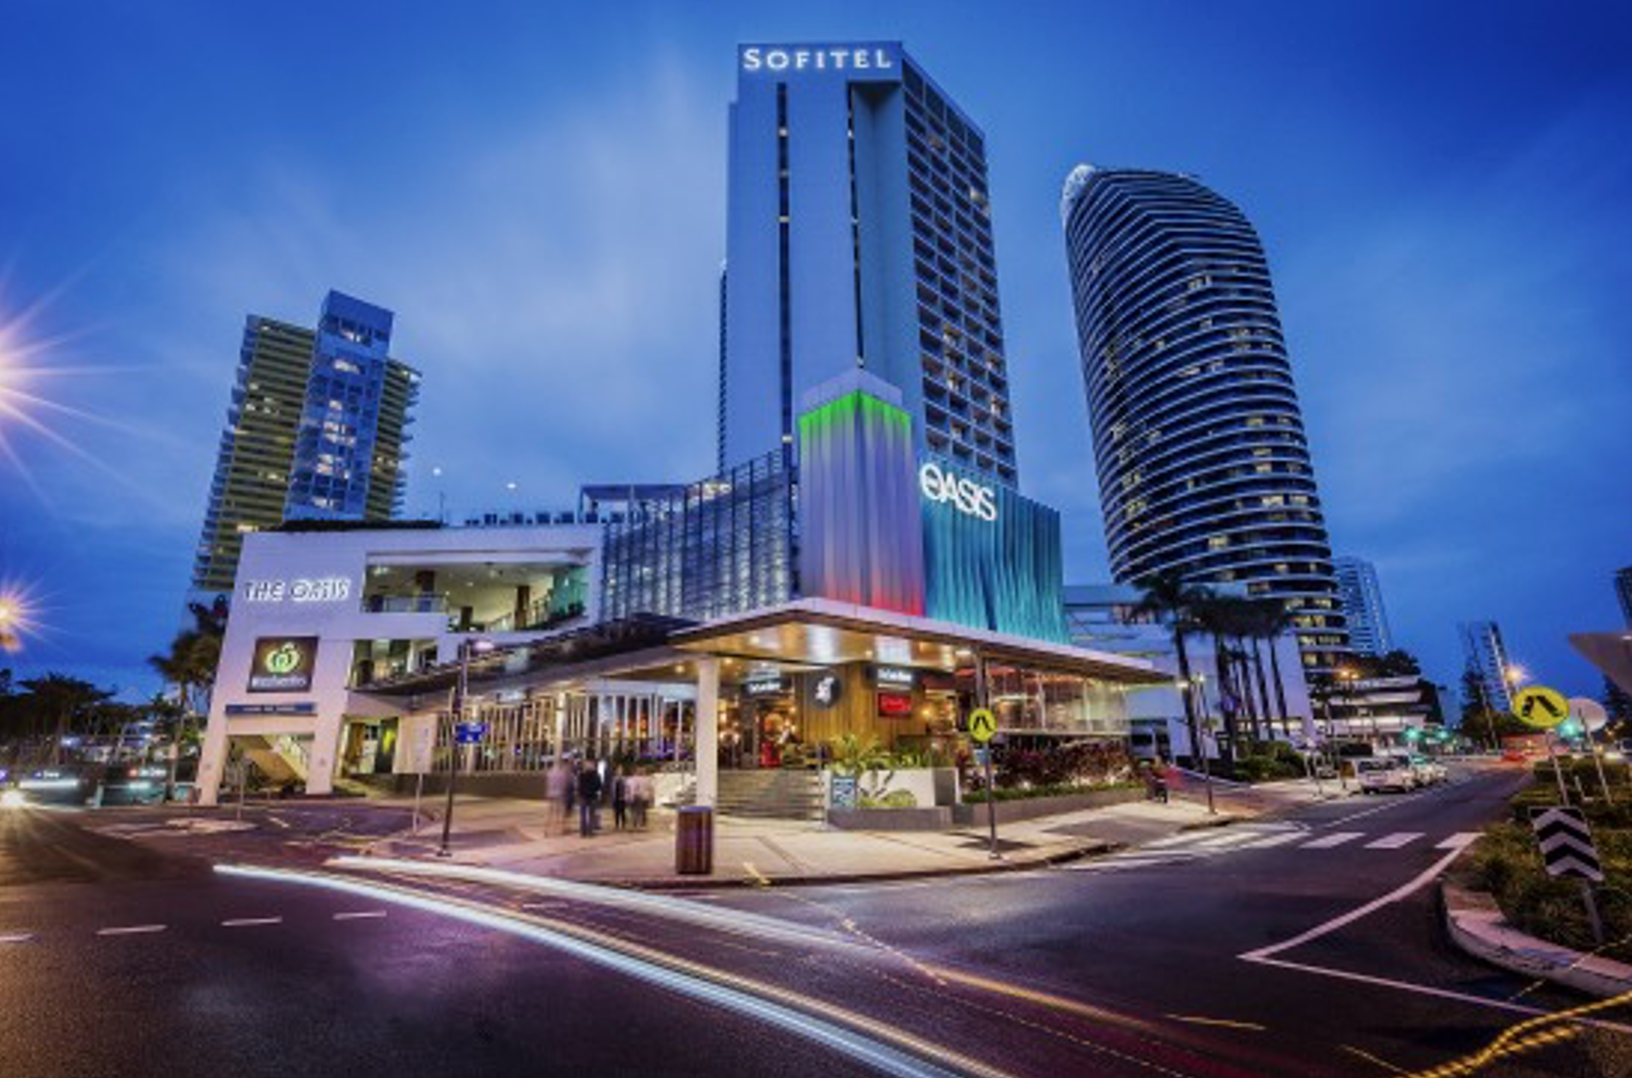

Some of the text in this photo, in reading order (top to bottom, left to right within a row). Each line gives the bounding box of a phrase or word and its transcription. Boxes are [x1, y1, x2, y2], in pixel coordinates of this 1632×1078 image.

[743, 48, 892, 70] SOFITEL
[920, 463, 997, 520] OASIS
[244, 580, 285, 601] THE
